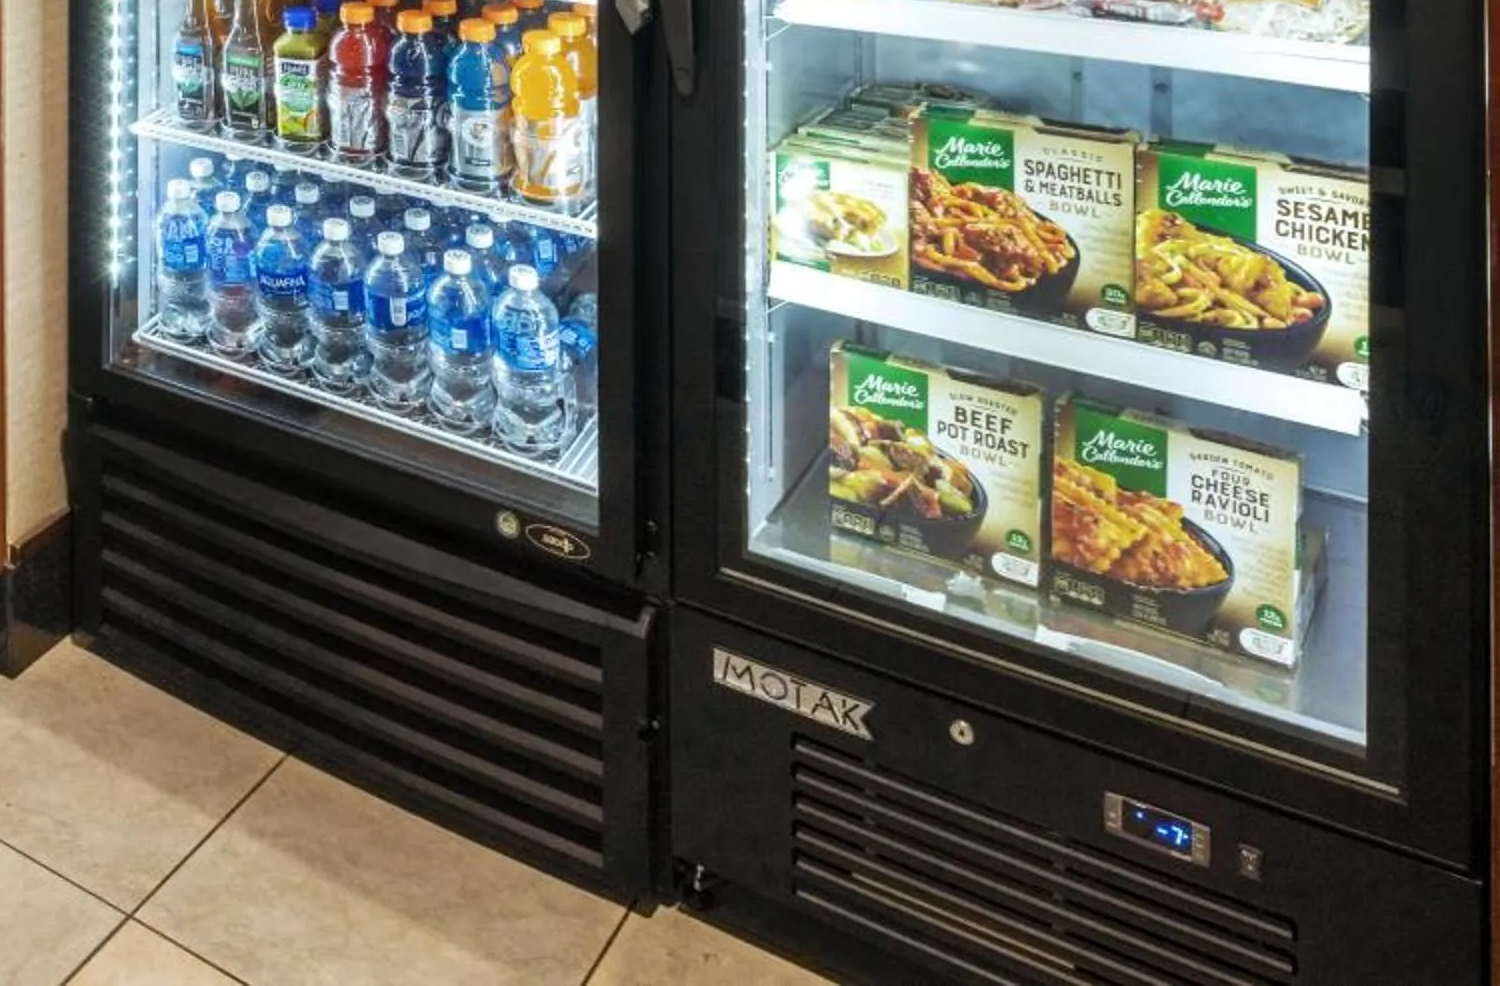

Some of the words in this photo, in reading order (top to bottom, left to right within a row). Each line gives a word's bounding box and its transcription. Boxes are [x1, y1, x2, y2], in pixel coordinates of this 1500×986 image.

[939, 135, 1004, 157] Marie
[1023, 158, 1122, 191] SPAGHETTI
[1166, 171, 1247, 194] Marie
[1024, 178, 1035, 193] &
[1039, 181, 1123, 207] MEATBALLS
[1331, 190, 1368, 207] SAVOR
[1048, 199, 1102, 219] BOWL
[1297, 243, 1356, 265] BOWL
[854, 373, 920, 397] Marie
[954, 405, 1013, 435] BEEF
[937, 419, 970, 441] POT
[973, 429, 1030, 459] ROAST
[1082, 430, 1157, 456] Marie
[959, 444, 1007, 467] BOWL
[1191, 474, 1270, 509] CHEESE
[1191, 489, 1270, 523] RAVIOLI
[1203, 509, 1259, 535] BOWL
[722, 656, 860, 731] MOTAK
